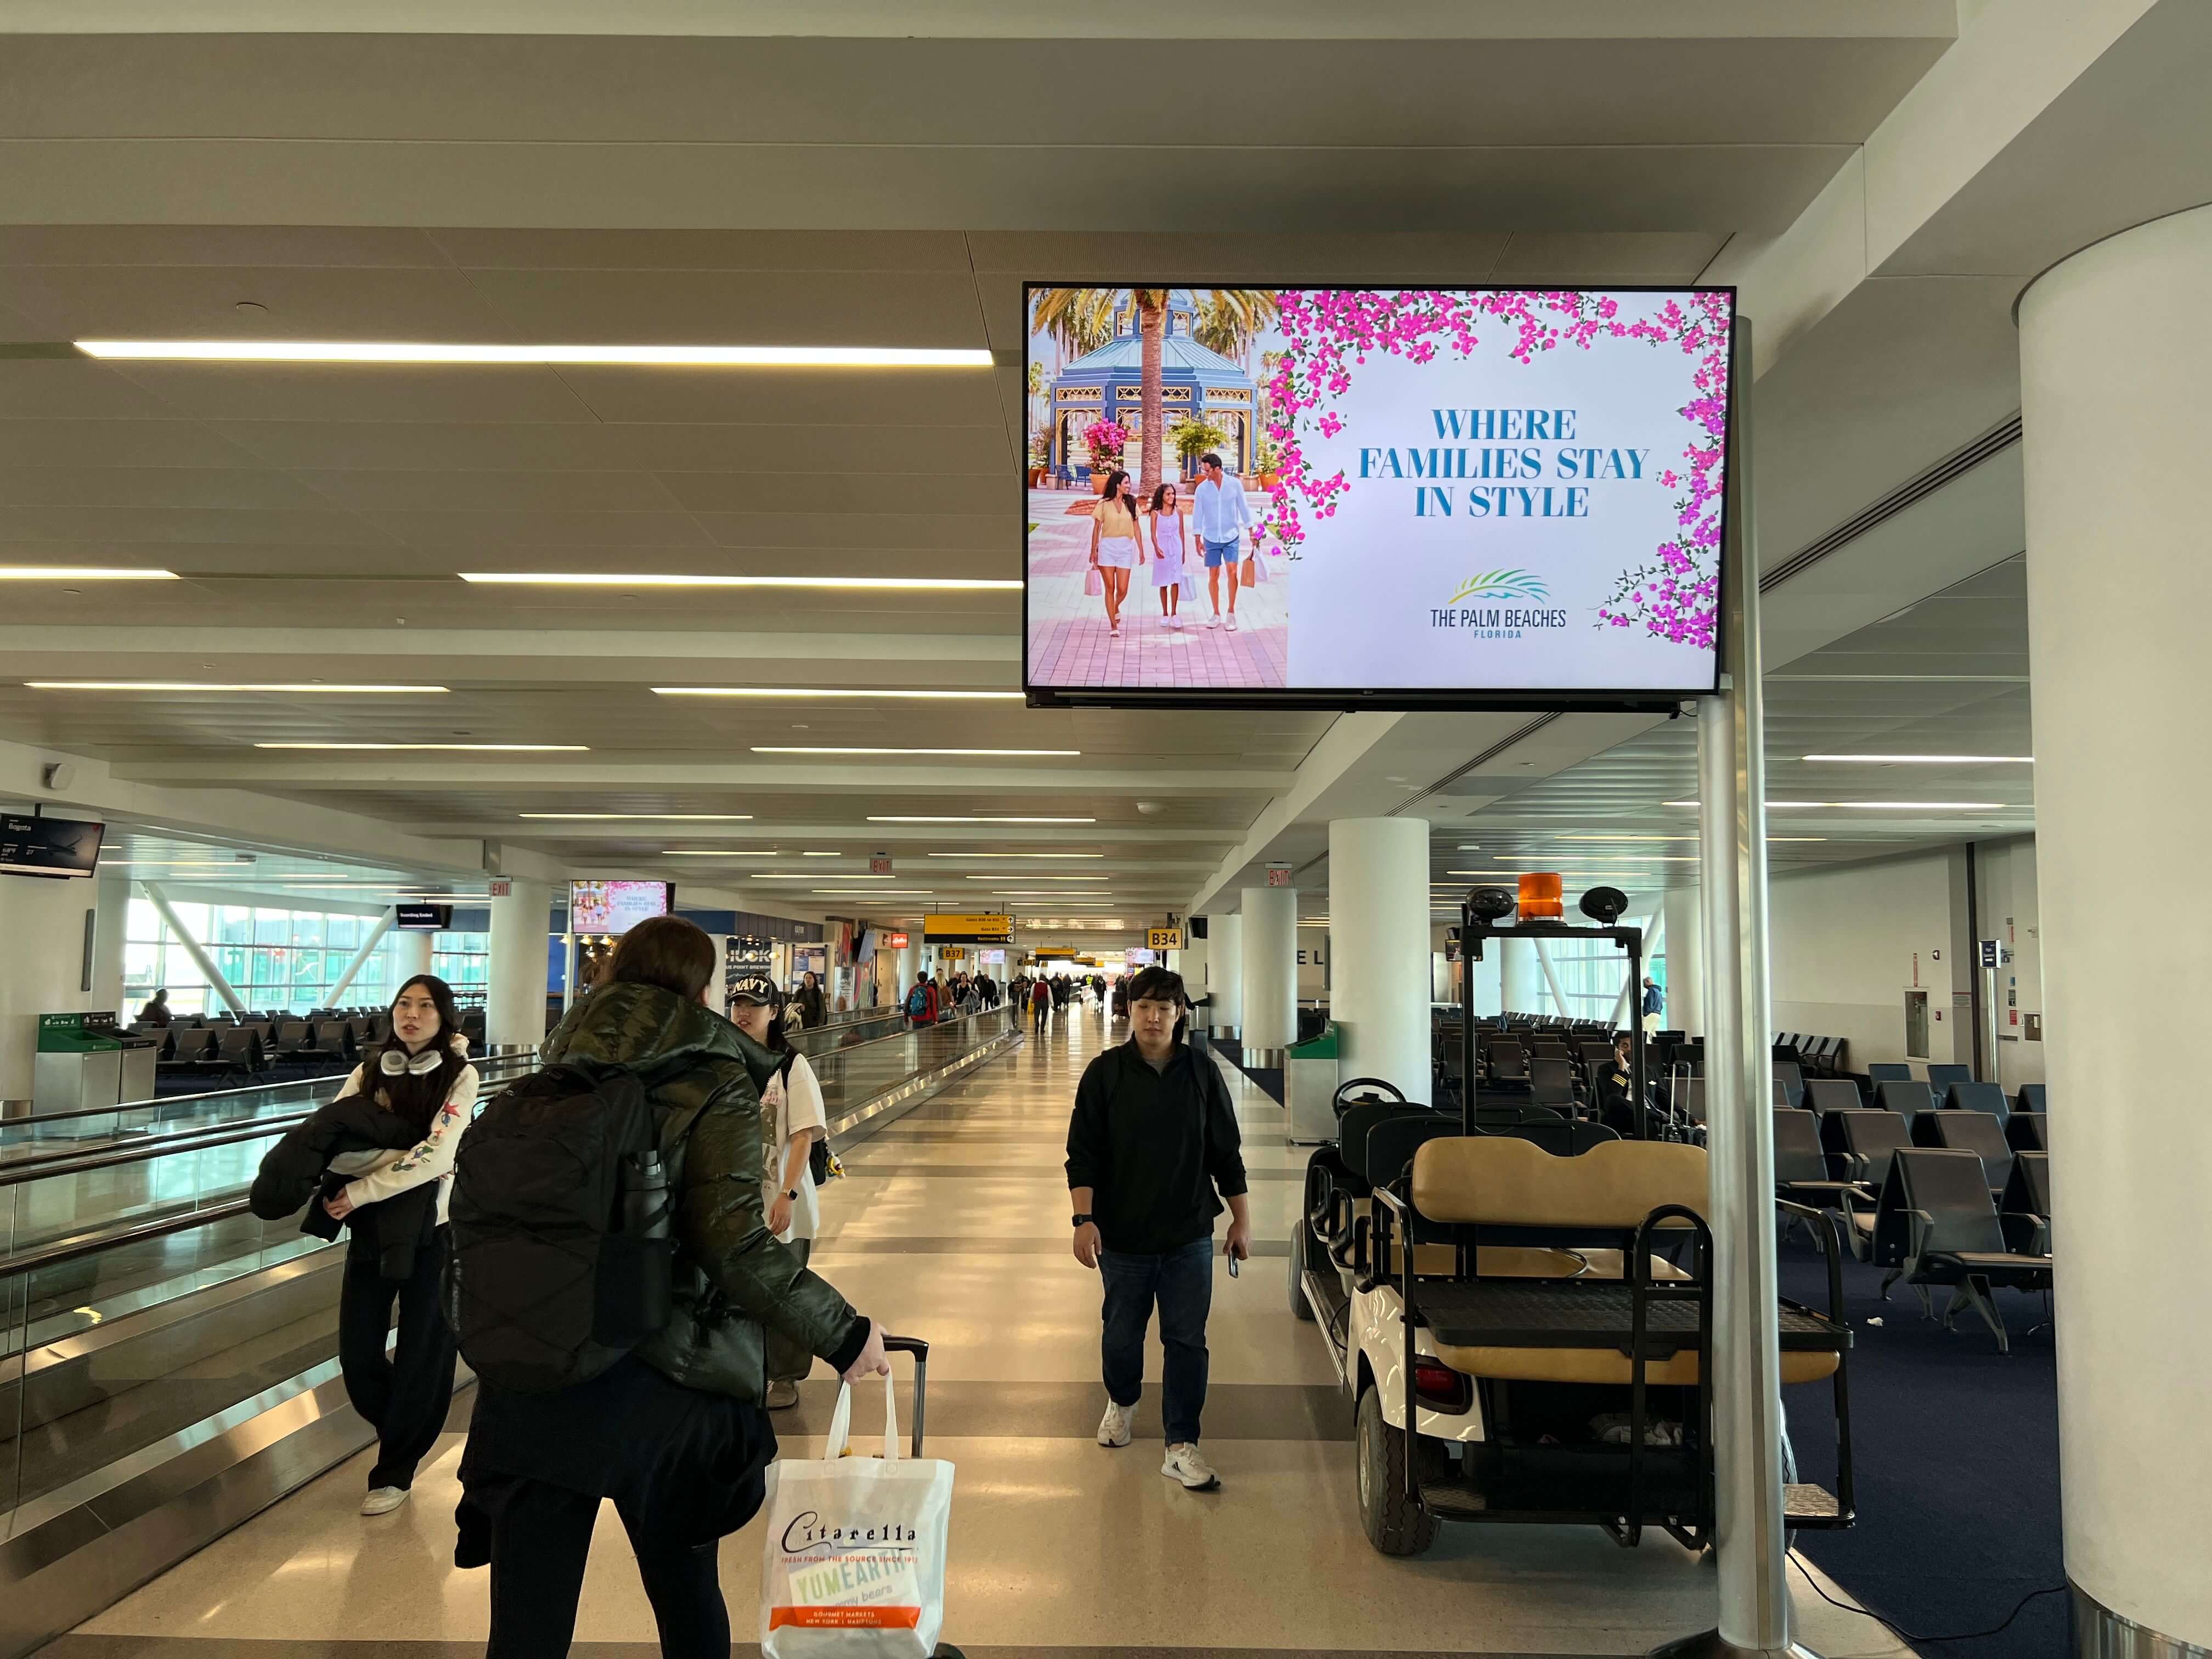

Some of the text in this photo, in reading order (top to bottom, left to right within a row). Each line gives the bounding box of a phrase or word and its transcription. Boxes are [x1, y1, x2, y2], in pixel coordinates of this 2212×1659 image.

[1431, 409, 1576, 439] WHERE
[1358, 448, 1650, 479] FAMILIES STAY
[1414, 486, 1589, 517] IN STYLE
[1431, 609, 1566, 628] THE PALM BEACHES
[1474, 630, 1521, 639] FLORIDA
[873, 860, 890, 873] EXIT
[1268, 869, 1289, 887] EXIT
[492, 883, 510, 896] EXIT
[1152, 933, 1177, 945] B34
[945, 950, 960, 958] B37
[733, 978, 768, 994] NAVY
[781, 1511, 916, 1553] Citarella
[797, 1548, 906, 1604] YUMEARTH
[861, 1585, 893, 1602] bears
